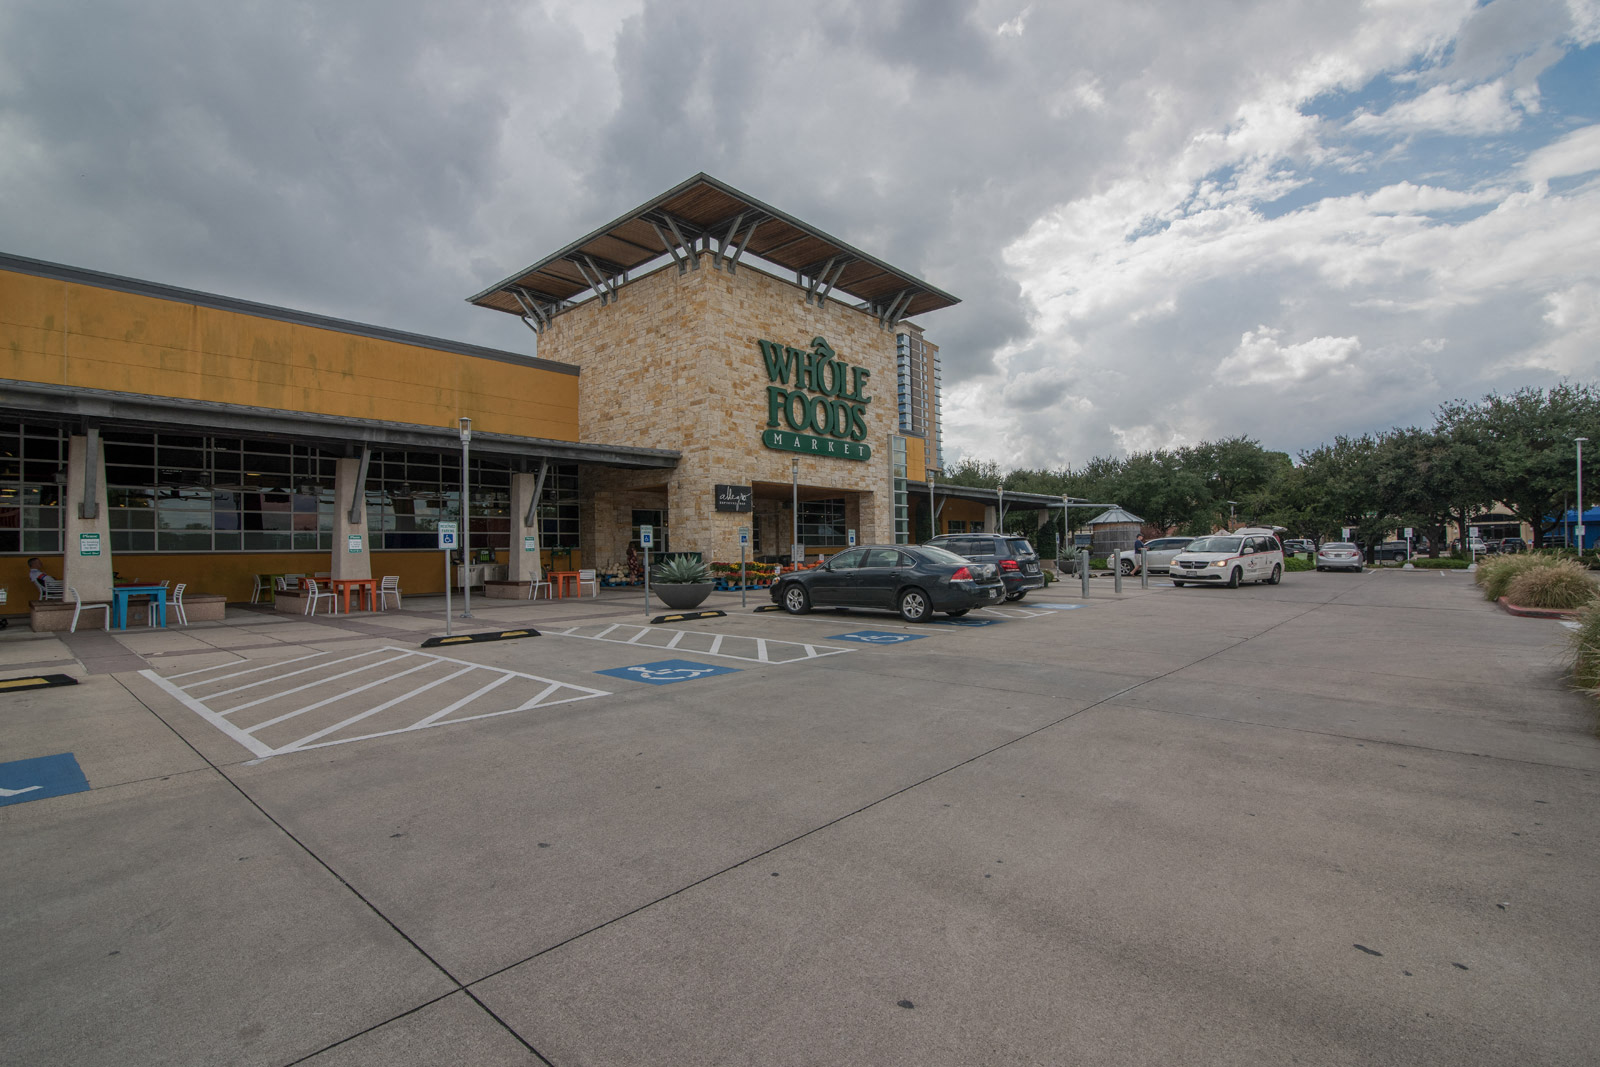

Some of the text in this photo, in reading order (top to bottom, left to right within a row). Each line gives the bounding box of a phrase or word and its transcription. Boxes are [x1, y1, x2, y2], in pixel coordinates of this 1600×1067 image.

[758, 338, 872, 403] WHOLE
[766, 386, 868, 441] FOODS
[774, 433, 865, 457] MARKET
